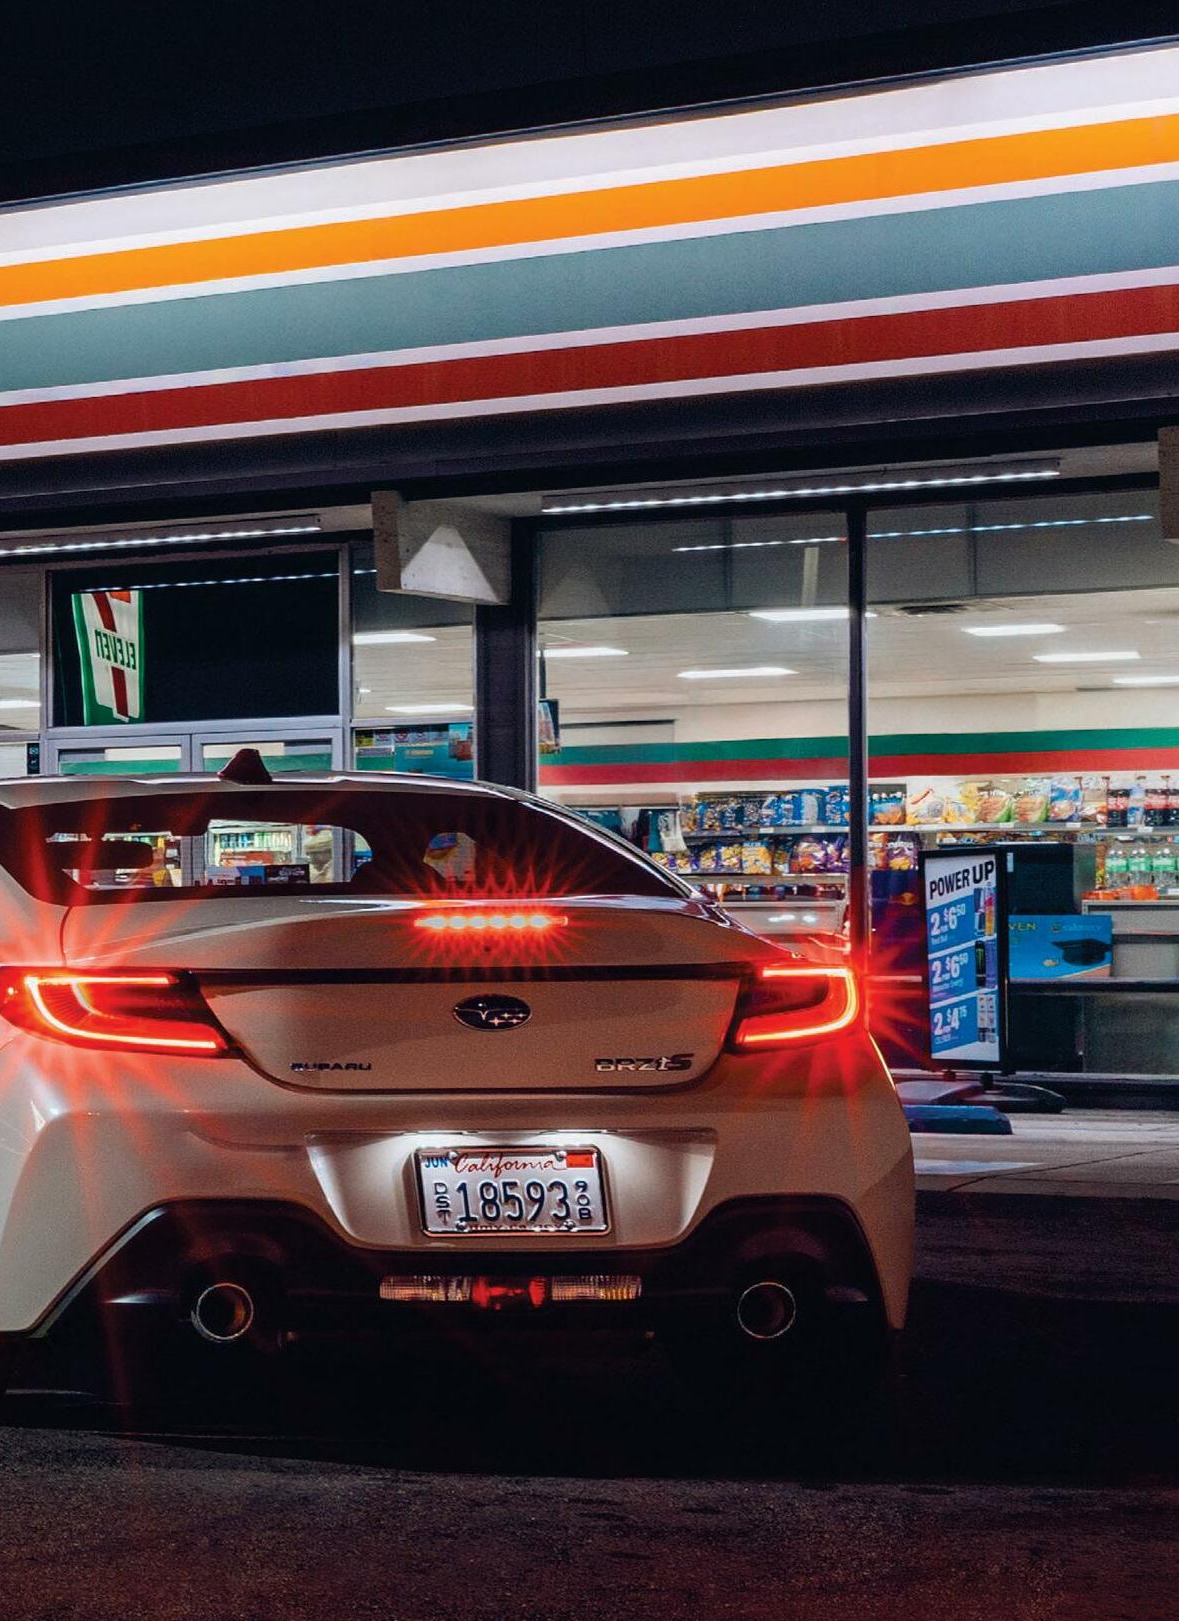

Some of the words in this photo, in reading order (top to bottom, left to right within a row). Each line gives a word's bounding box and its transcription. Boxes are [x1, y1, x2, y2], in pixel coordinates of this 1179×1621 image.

[929, 868, 971, 900] POWER
[972, 860, 995, 884] UP
[930, 912, 941, 936] 2
[932, 960, 942, 984] 2
[933, 1012, 943, 1035] 2
[424, 1157, 449, 1168] JUN
[454, 1153, 568, 1178] California
[456, 1180, 571, 1223] 18593
